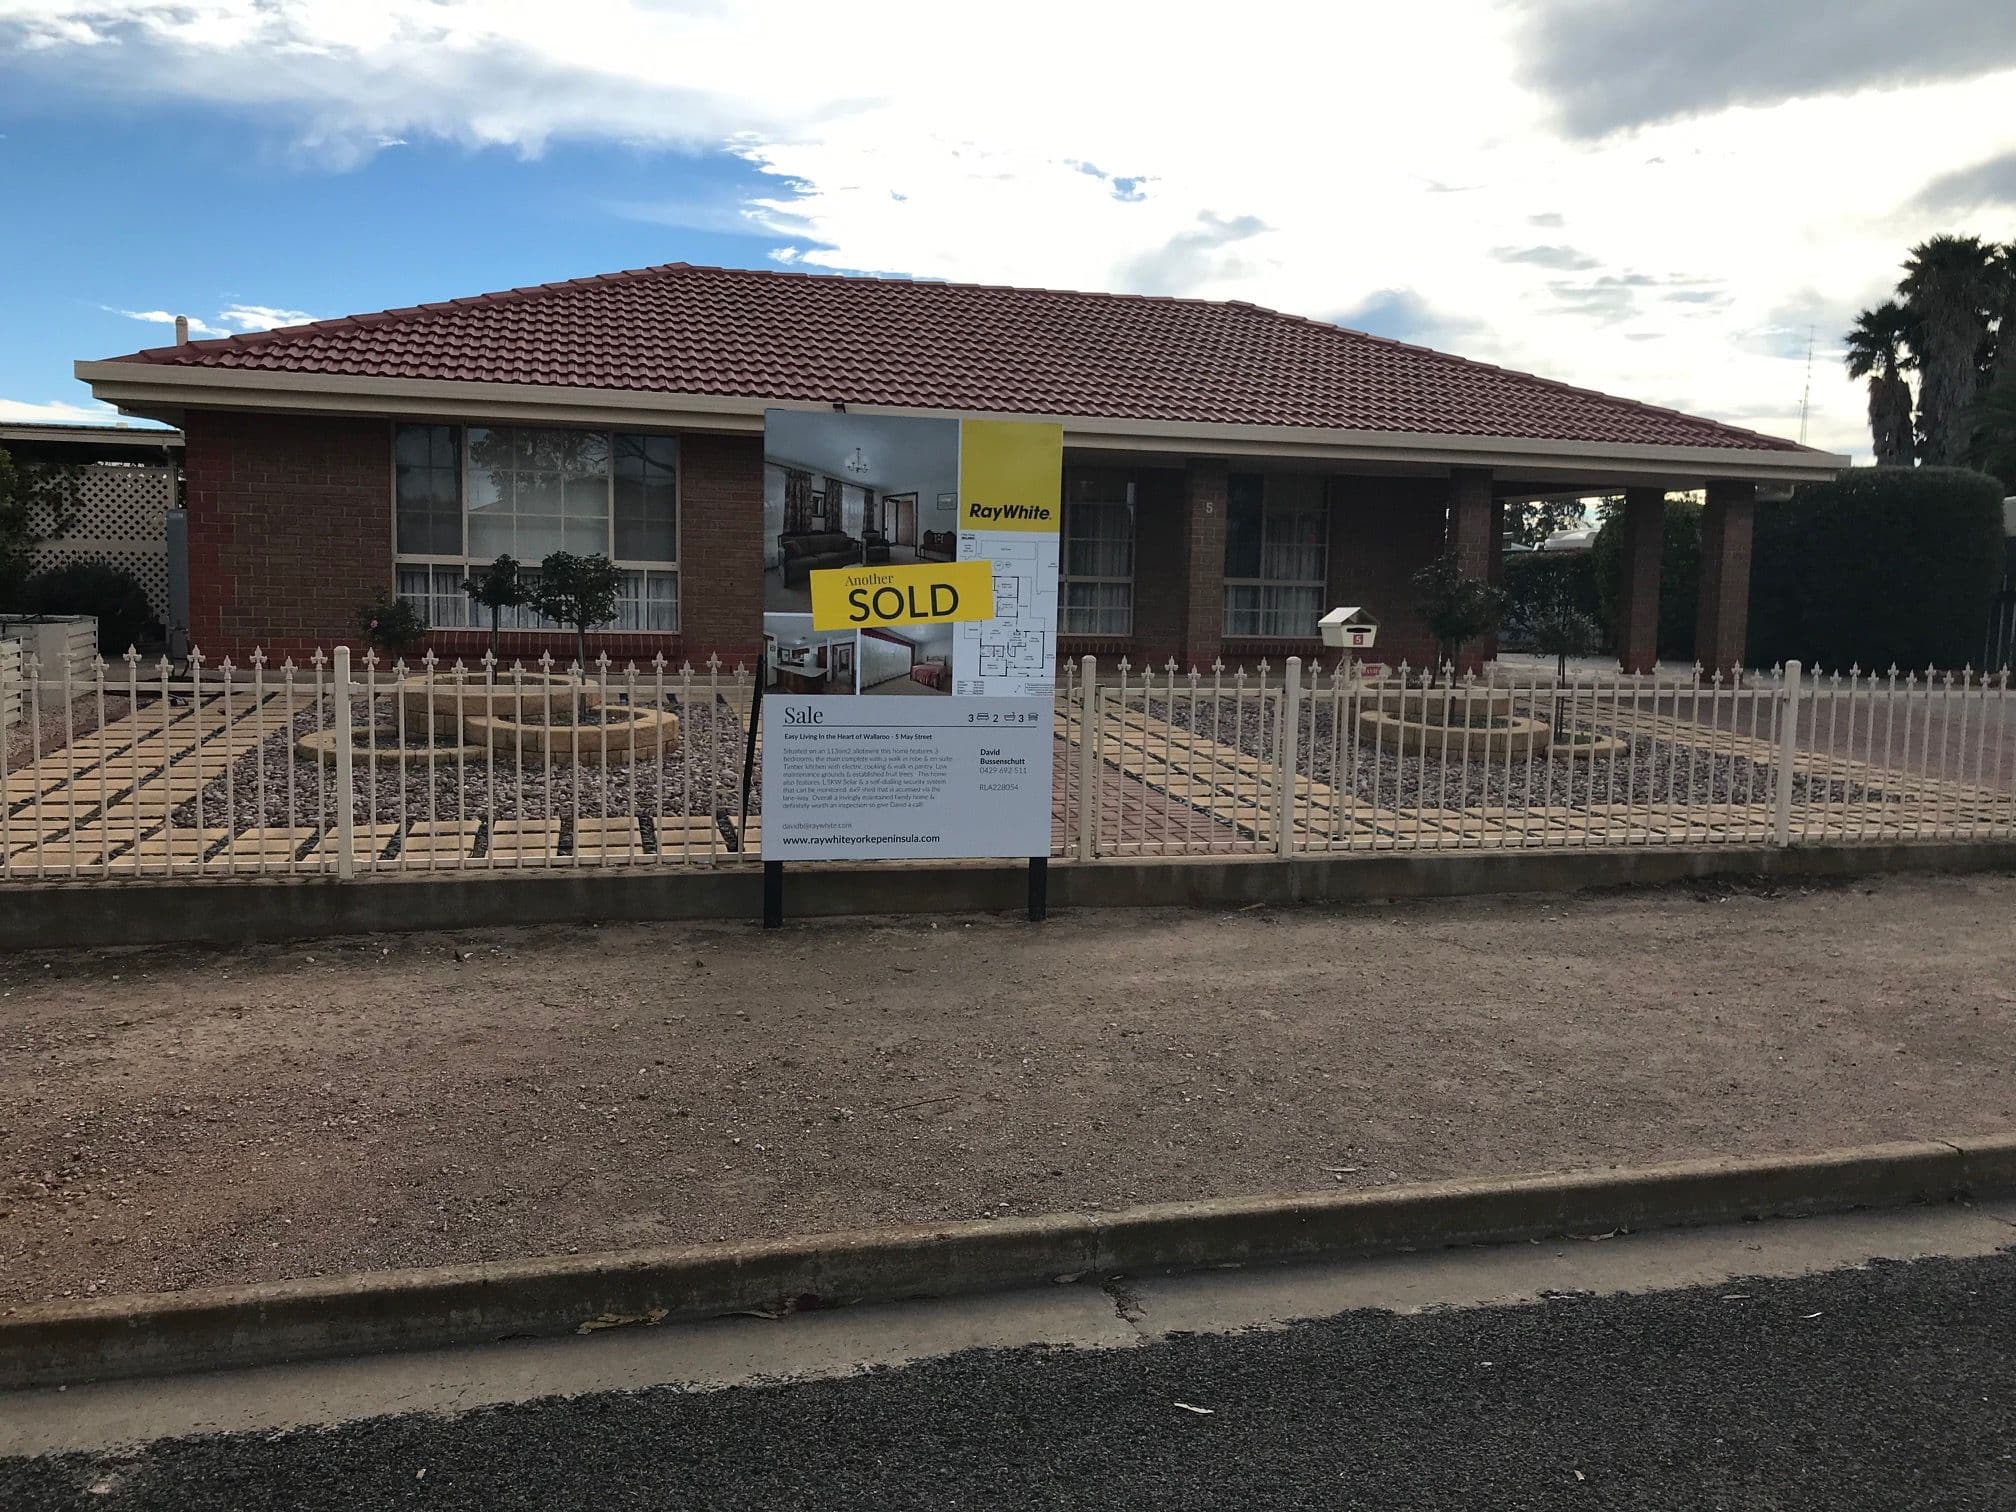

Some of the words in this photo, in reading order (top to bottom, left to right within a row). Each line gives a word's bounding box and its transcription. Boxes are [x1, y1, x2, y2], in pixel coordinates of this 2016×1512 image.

[1205, 502, 1213, 514] 5
[846, 573, 894, 587] Another
[848, 583, 959, 622] SOLD
[1354, 634, 1362, 644] 5
[784, 706, 824, 725] Sale
[968, 713, 974, 723] 3
[992, 714, 999, 723] 2
[1018, 714, 1024, 723] 3
[783, 834, 940, 845] www.raywhiteyorkepeninsula.com
